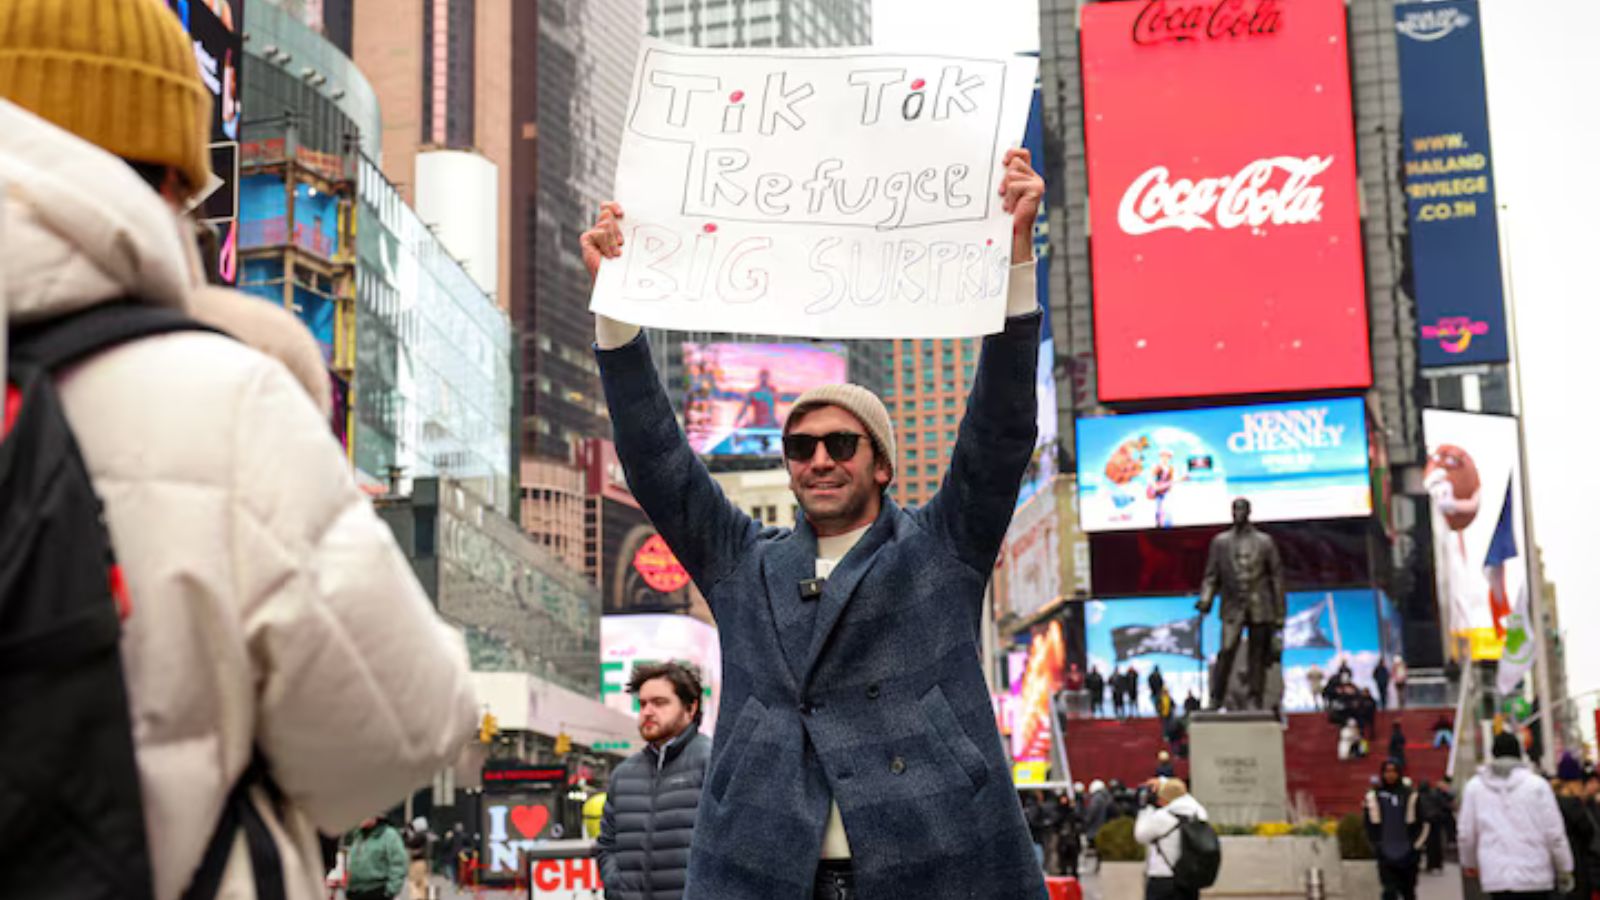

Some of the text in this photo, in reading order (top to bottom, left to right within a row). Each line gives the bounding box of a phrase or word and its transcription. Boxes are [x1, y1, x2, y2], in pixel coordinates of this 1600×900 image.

[701, 147, 972, 232] Refugee
[1117, 154, 1335, 236] Coca-Cola
[1405, 176, 1488, 199] RIVILEGE
[1242, 406, 1328, 433] KENNY
[1227, 424, 1345, 453] CHESNEY
[488, 805, 508, 840] I
